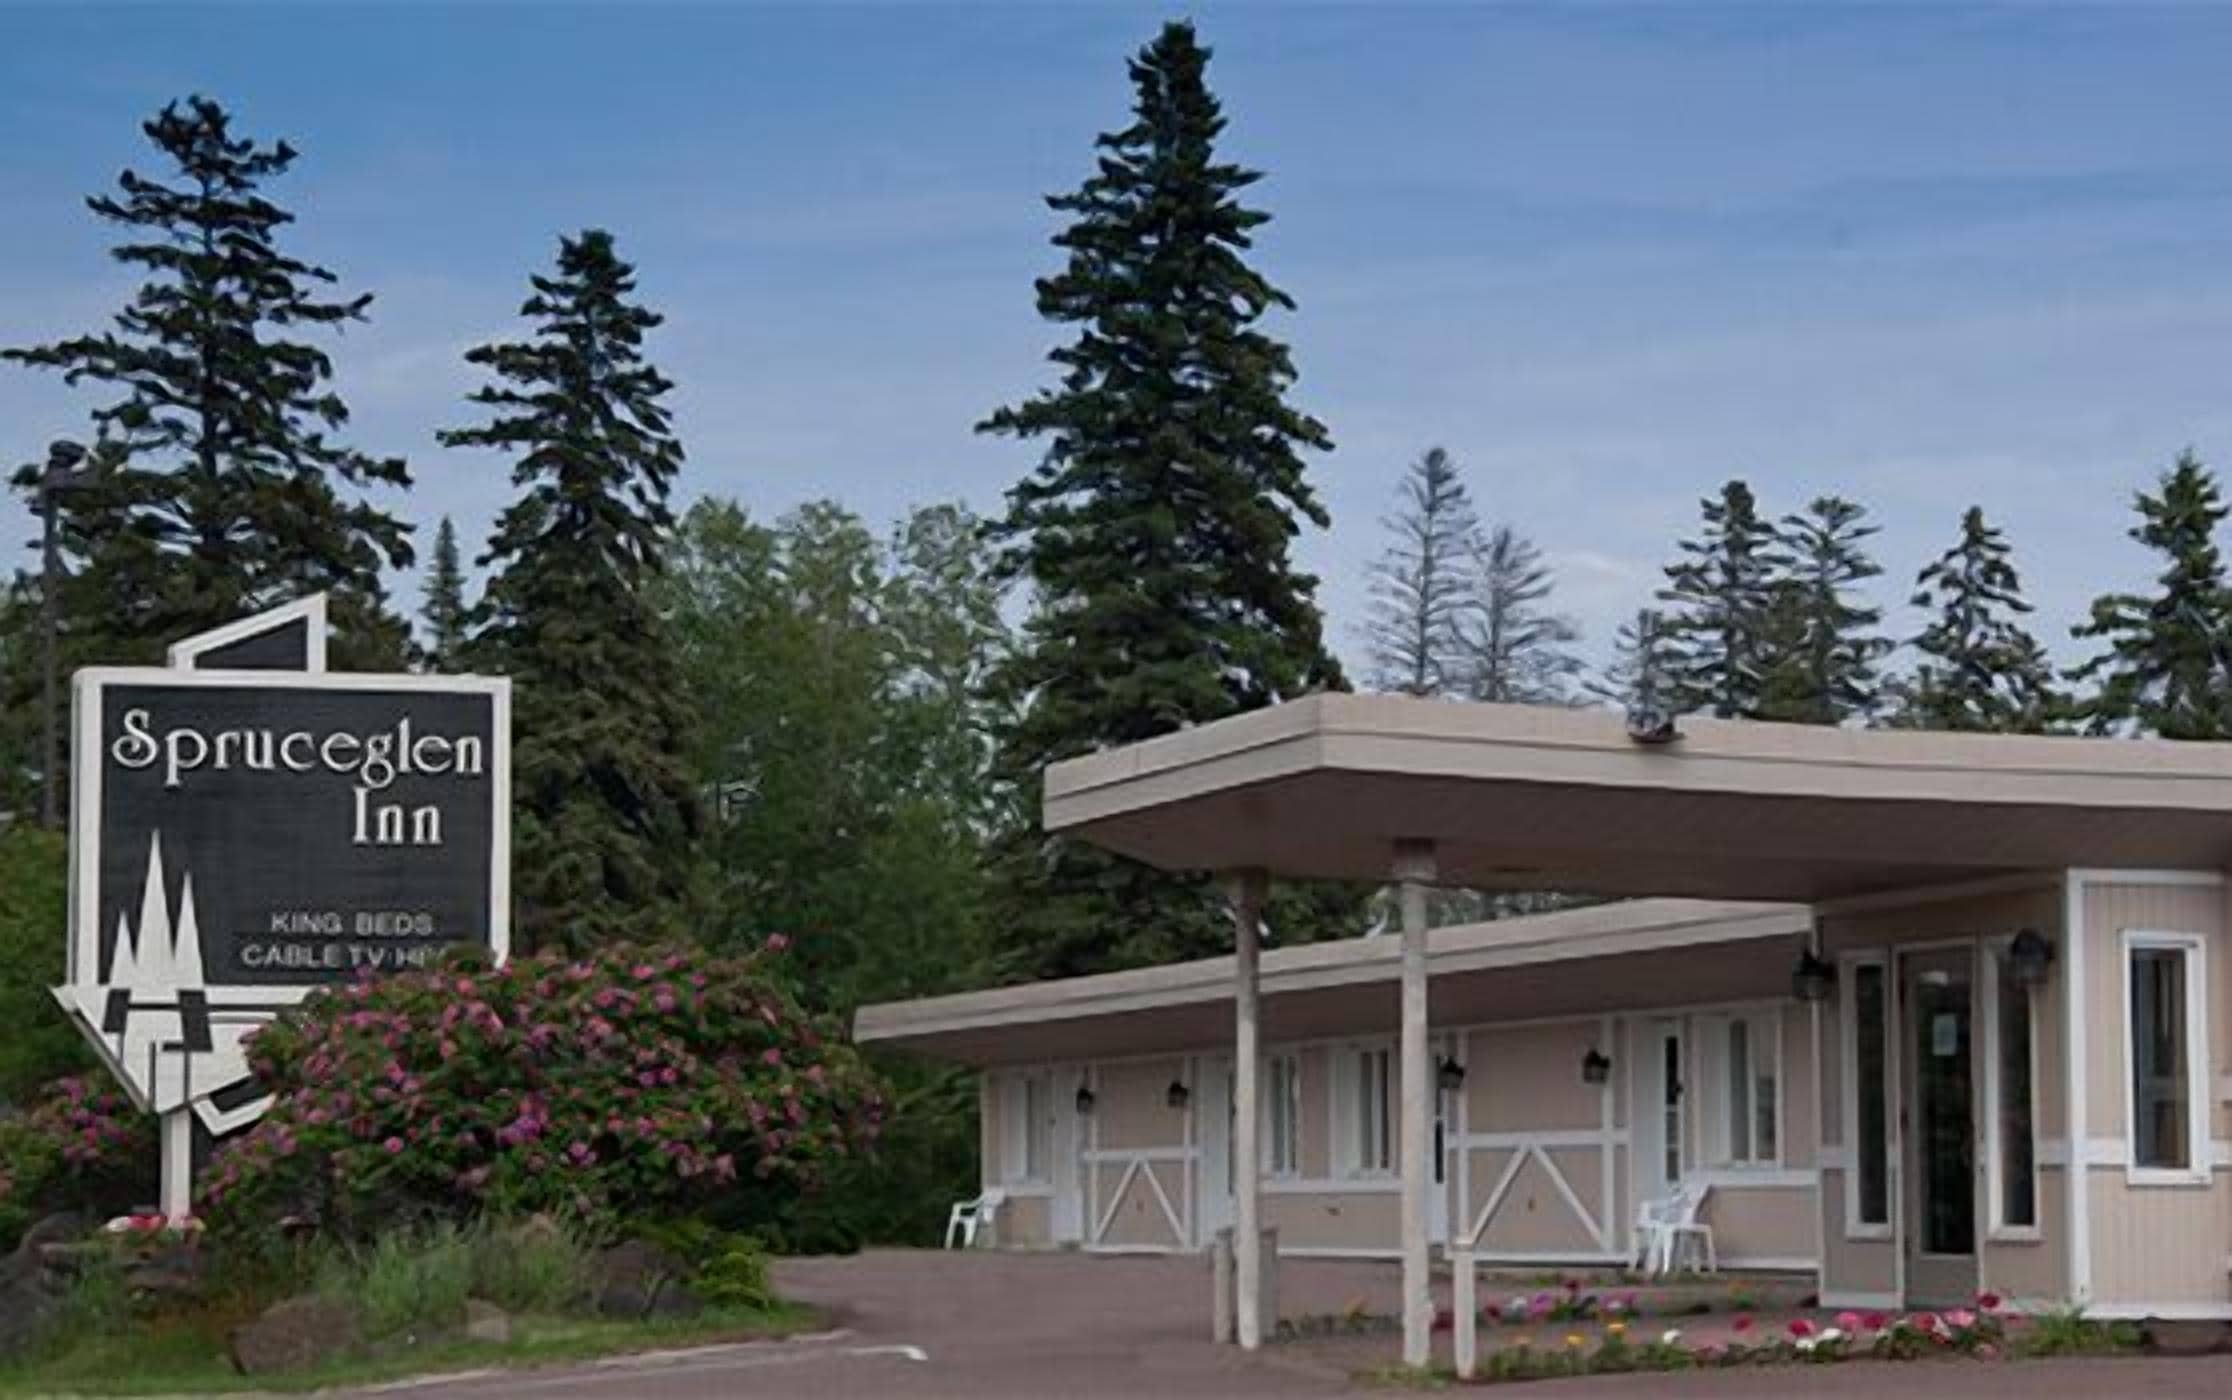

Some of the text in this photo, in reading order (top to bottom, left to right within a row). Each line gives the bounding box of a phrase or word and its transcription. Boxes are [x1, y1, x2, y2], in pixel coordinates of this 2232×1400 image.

[111, 708, 483, 788] Spruceglen
[352, 786, 443, 845] Inn
[270, 912, 433, 936] KING BEDS
[241, 944, 339, 968] CABLE
[349, 946, 385, 967] TV
